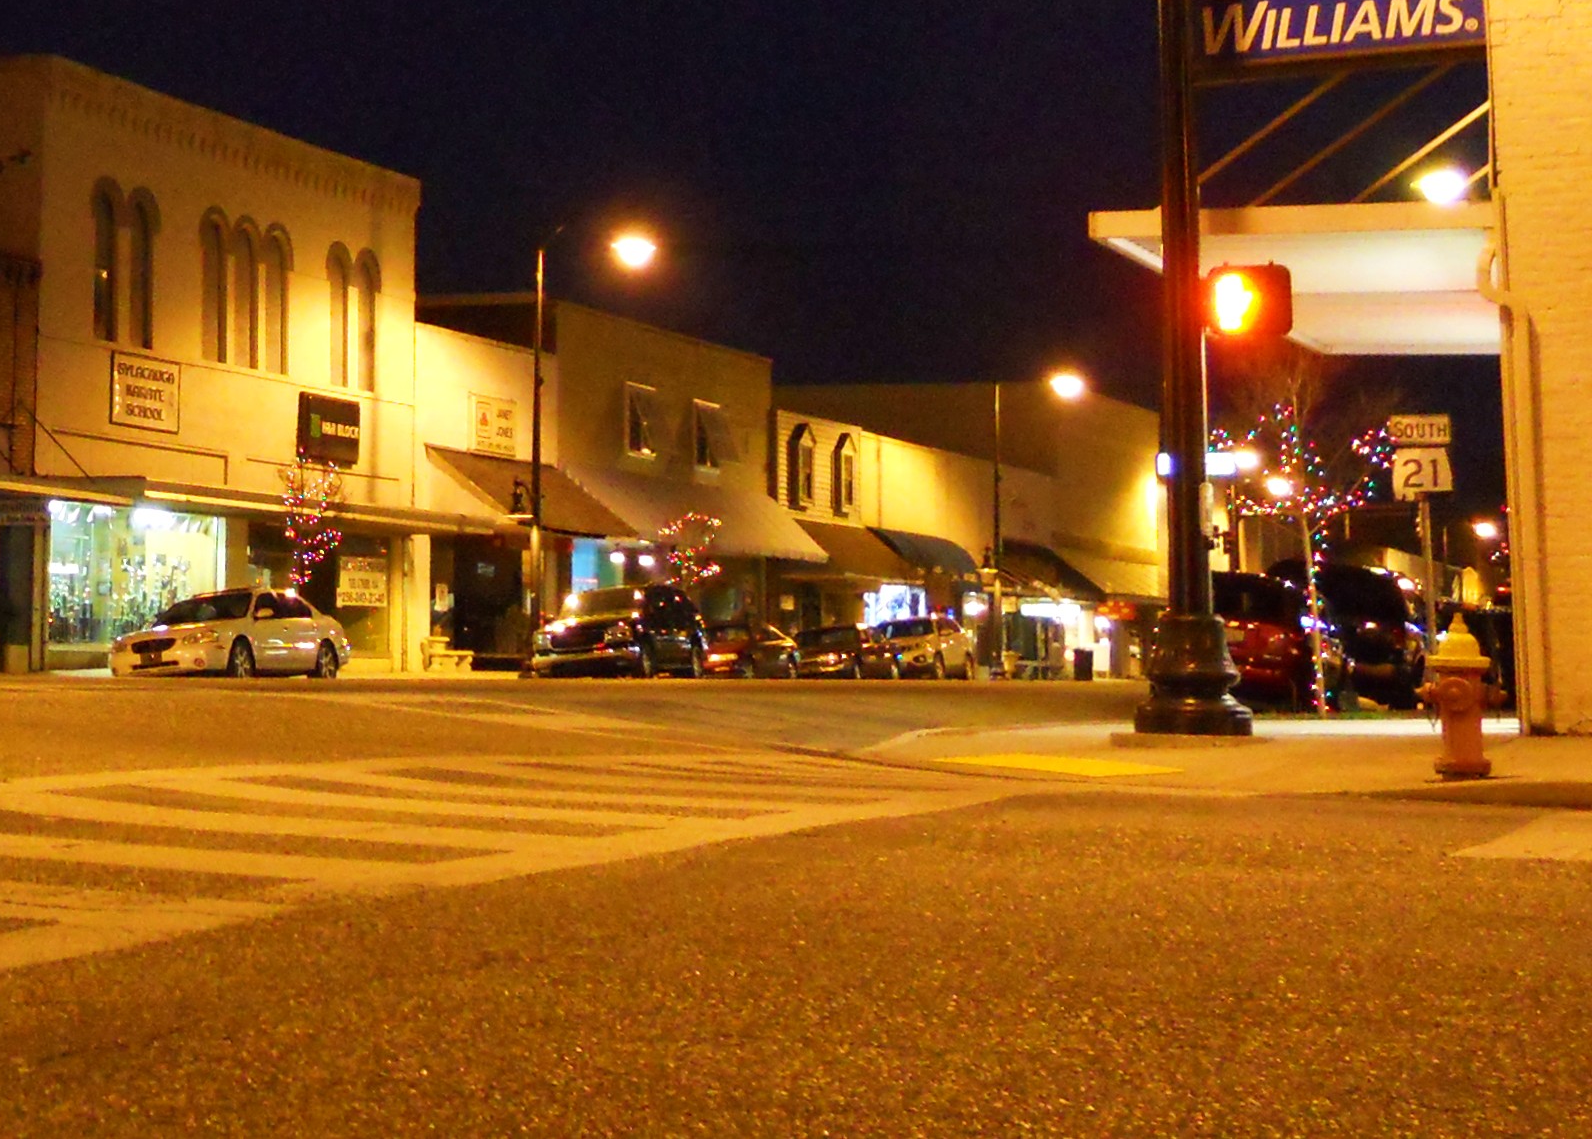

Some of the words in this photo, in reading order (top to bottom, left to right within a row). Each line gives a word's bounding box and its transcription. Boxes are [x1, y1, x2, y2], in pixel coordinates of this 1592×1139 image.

[116, 362, 175, 385] SYLACAUGA
[126, 384, 165, 402] KARATE
[126, 403, 165, 421] SCHOOL
[337, 423, 359, 440] BLOCK
[1393, 421, 1447, 438] SOUTH
[1402, 459, 1438, 488] 21
